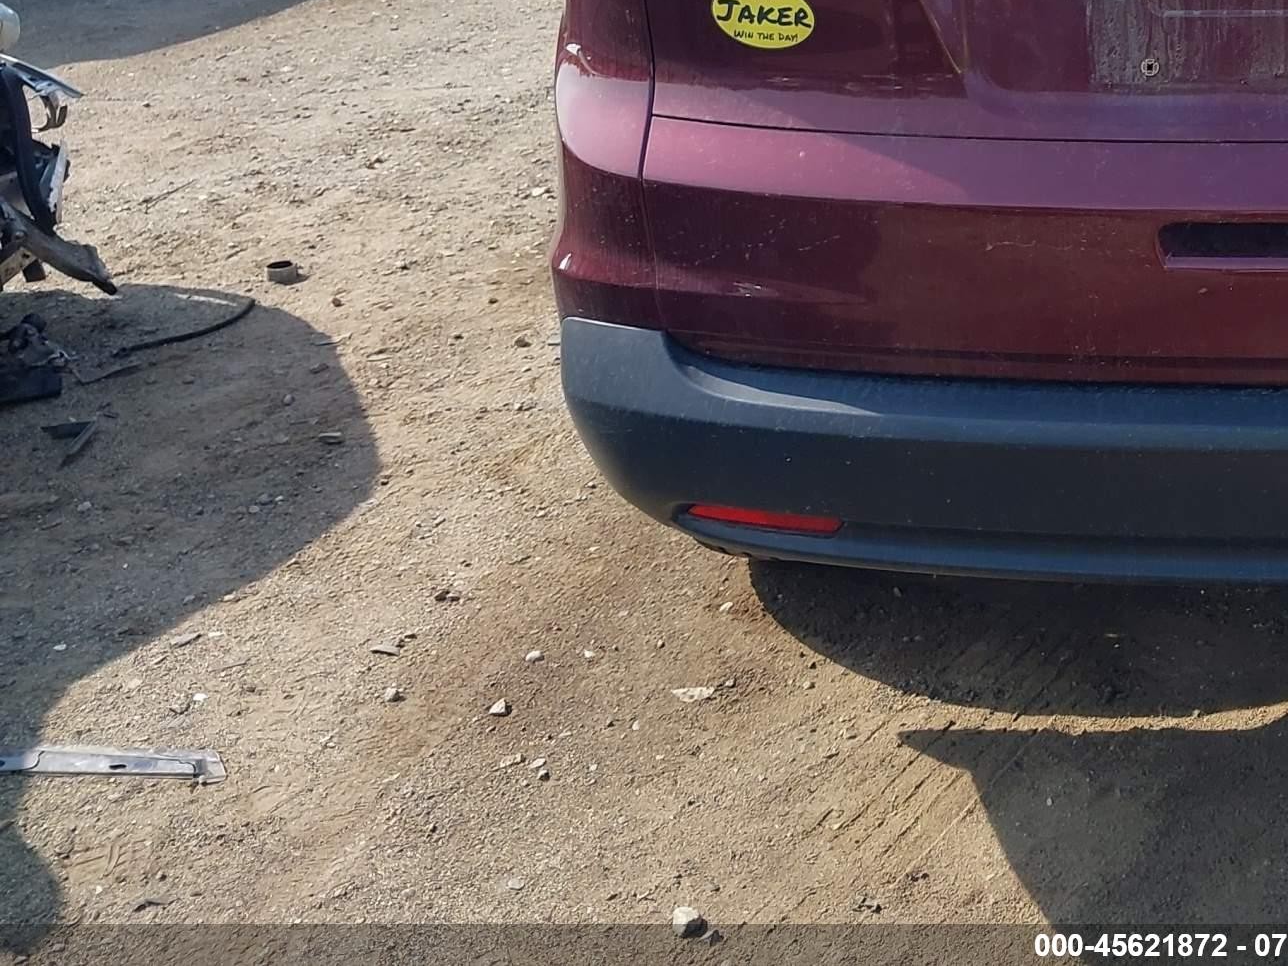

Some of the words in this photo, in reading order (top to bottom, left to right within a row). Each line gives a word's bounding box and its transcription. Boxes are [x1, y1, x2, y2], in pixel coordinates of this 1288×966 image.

[733, 29, 754, 40] WIN
[757, 32, 775, 42] THE
[778, 32, 799, 44] DAY!
